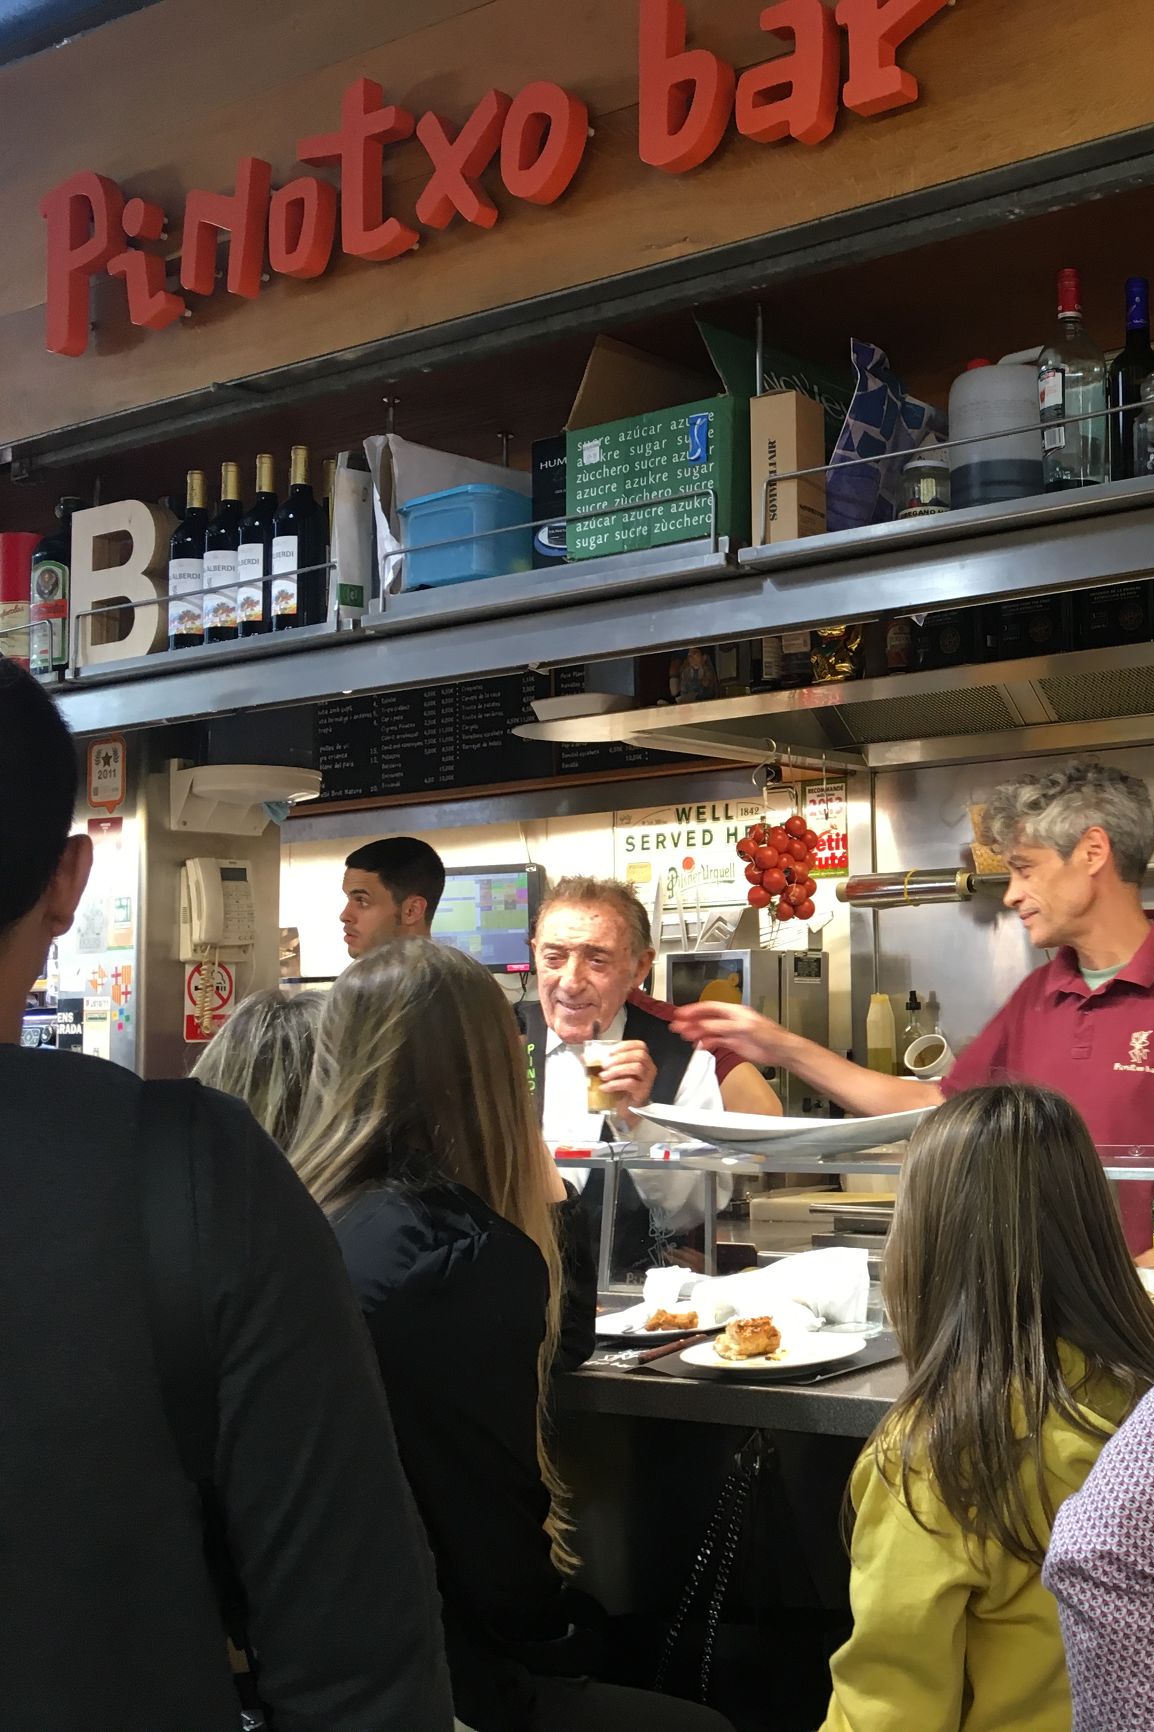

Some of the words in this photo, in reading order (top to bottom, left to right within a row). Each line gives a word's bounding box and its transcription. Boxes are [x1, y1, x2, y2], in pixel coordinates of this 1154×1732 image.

[639, 0, 950, 173] bar
[576, 449, 620, 467] akre
[629, 438, 667, 456] sugar
[677, 428, 714, 445] sue
[577, 435, 610, 452] sre
[618, 423, 662, 442] azúcar
[670, 411, 714, 430] azue
[576, 463, 630, 483] zùcchero
[634, 455, 667, 471] sucre
[672, 444, 714, 463] azr
[576, 482, 617, 500] azucre
[625, 471, 669, 489] azukre
[677, 461, 714, 480] sugar
[575, 514, 617, 533] azúcar
[622, 506, 664, 523] azucre
[670, 495, 714, 513] azukre
[576, 500, 608, 514] sucre
[614, 487, 672, 507] zùcchero
[679, 479, 714, 495] sucre
[575, 532, 609, 550] sugar
[614, 525, 648, 541] sucre
[654, 513, 713, 534] zùcchero
[240, 558, 260, 566] BERDI
[273, 551, 294, 560] BERDI
[71, 499, 158, 667] B
[97, 769, 117, 780] 2011
[676, 803, 735, 825] WELL
[739, 806, 760, 816] 1842
[625, 828, 714, 853] SERVED
